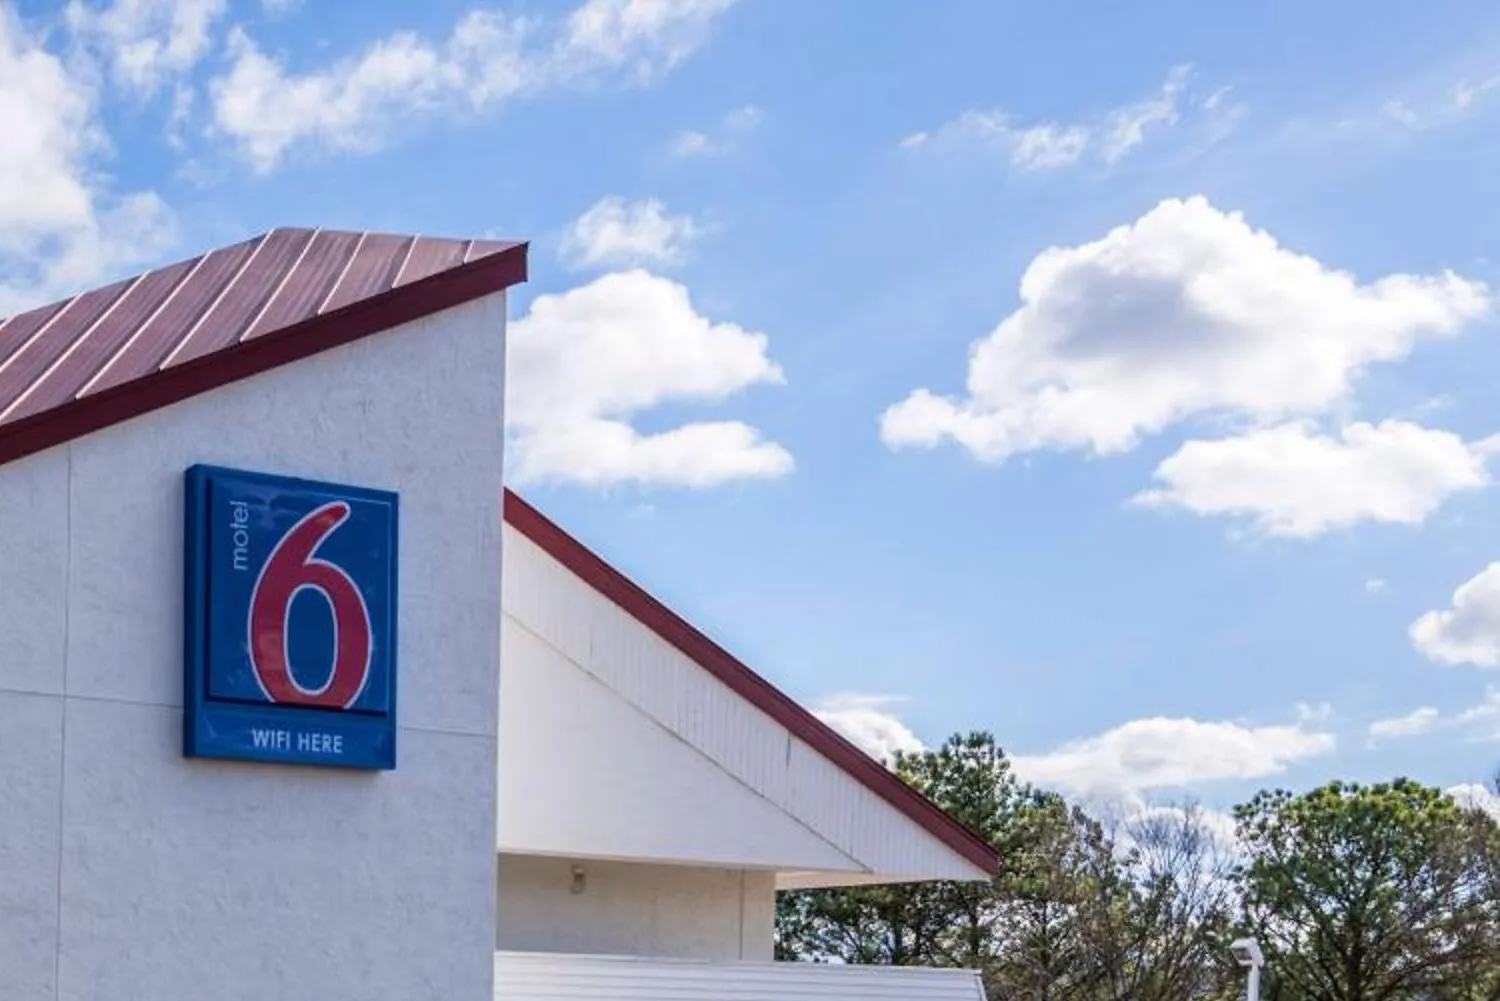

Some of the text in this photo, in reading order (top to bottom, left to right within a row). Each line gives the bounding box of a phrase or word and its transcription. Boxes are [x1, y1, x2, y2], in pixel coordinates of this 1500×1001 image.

[230, 500, 248, 570] motel
[247, 500, 372, 709] 6
[251, 728, 343, 753] WIFI HERE
